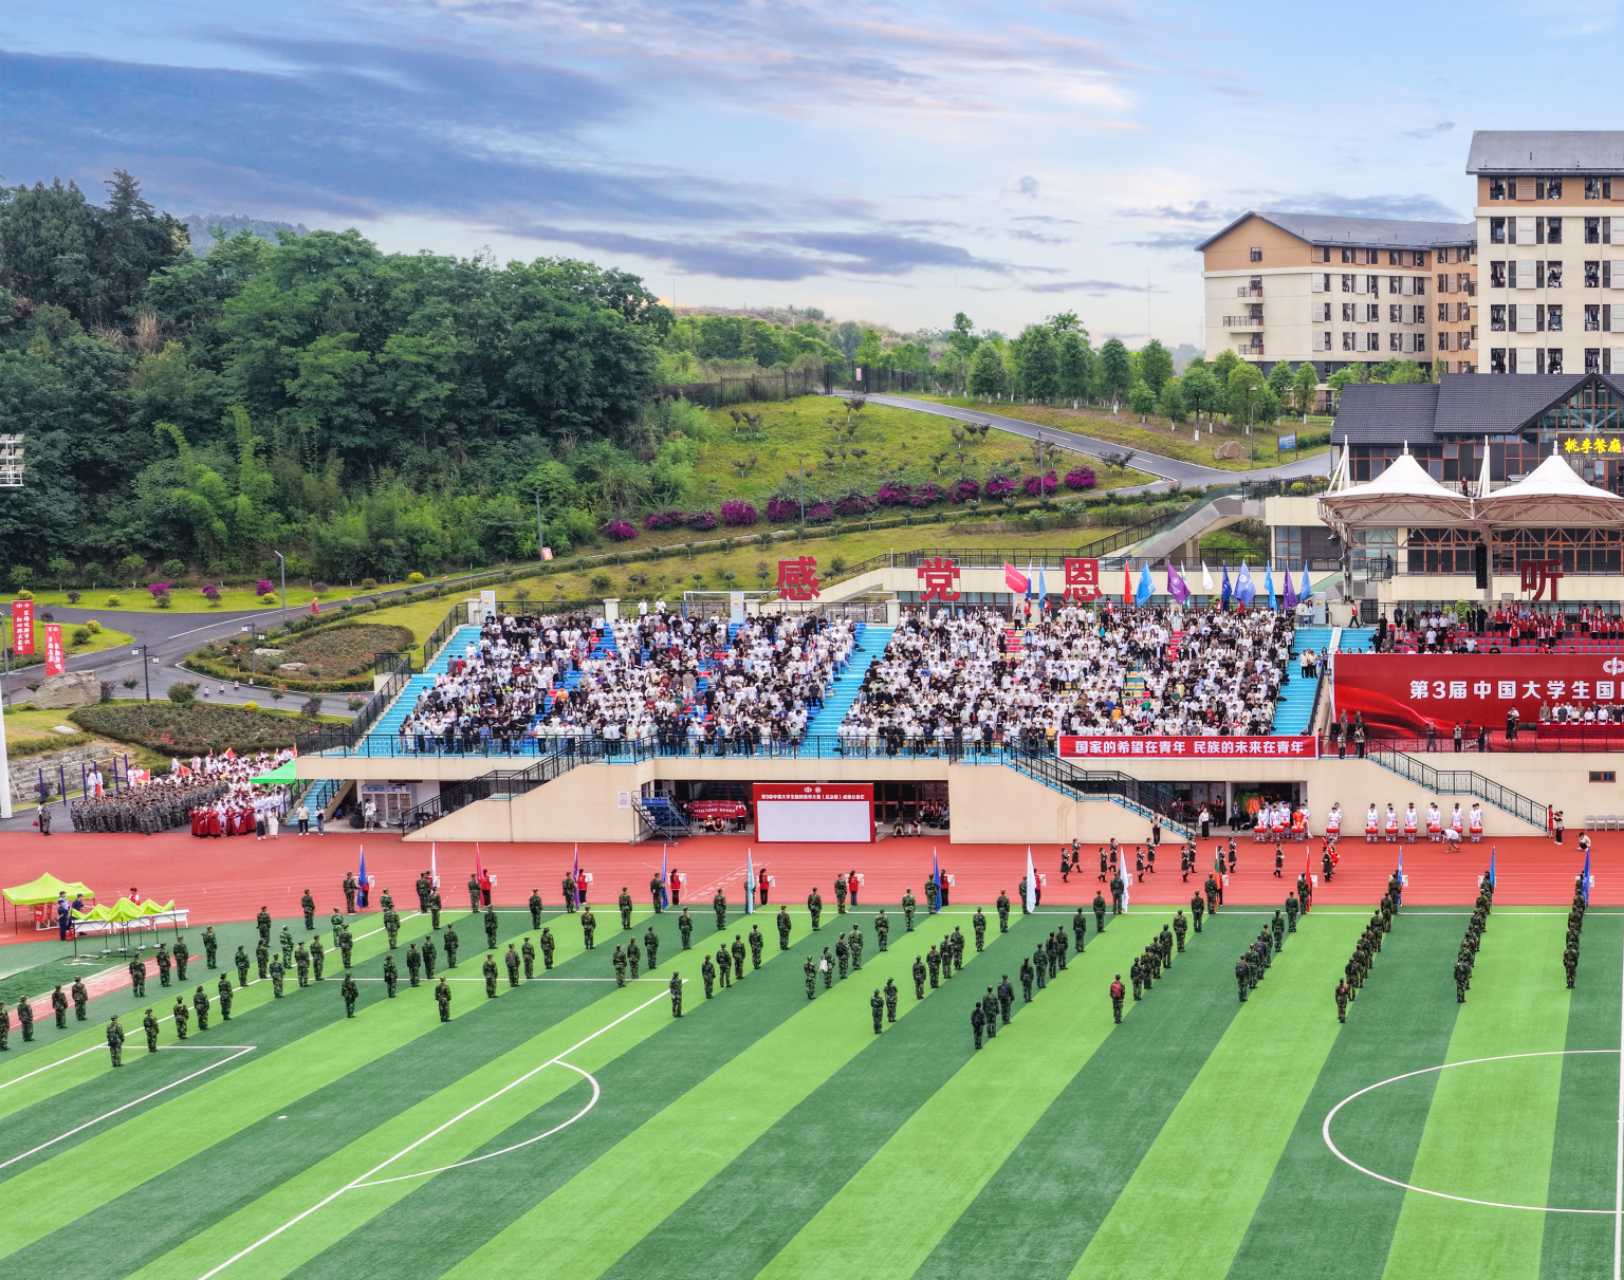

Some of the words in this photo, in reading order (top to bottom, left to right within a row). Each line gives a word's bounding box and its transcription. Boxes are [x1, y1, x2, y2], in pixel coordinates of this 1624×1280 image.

[1075, 740, 1187, 754] 国家的希望在青年
[1194, 740, 1304, 754] 民族的未来在青年
